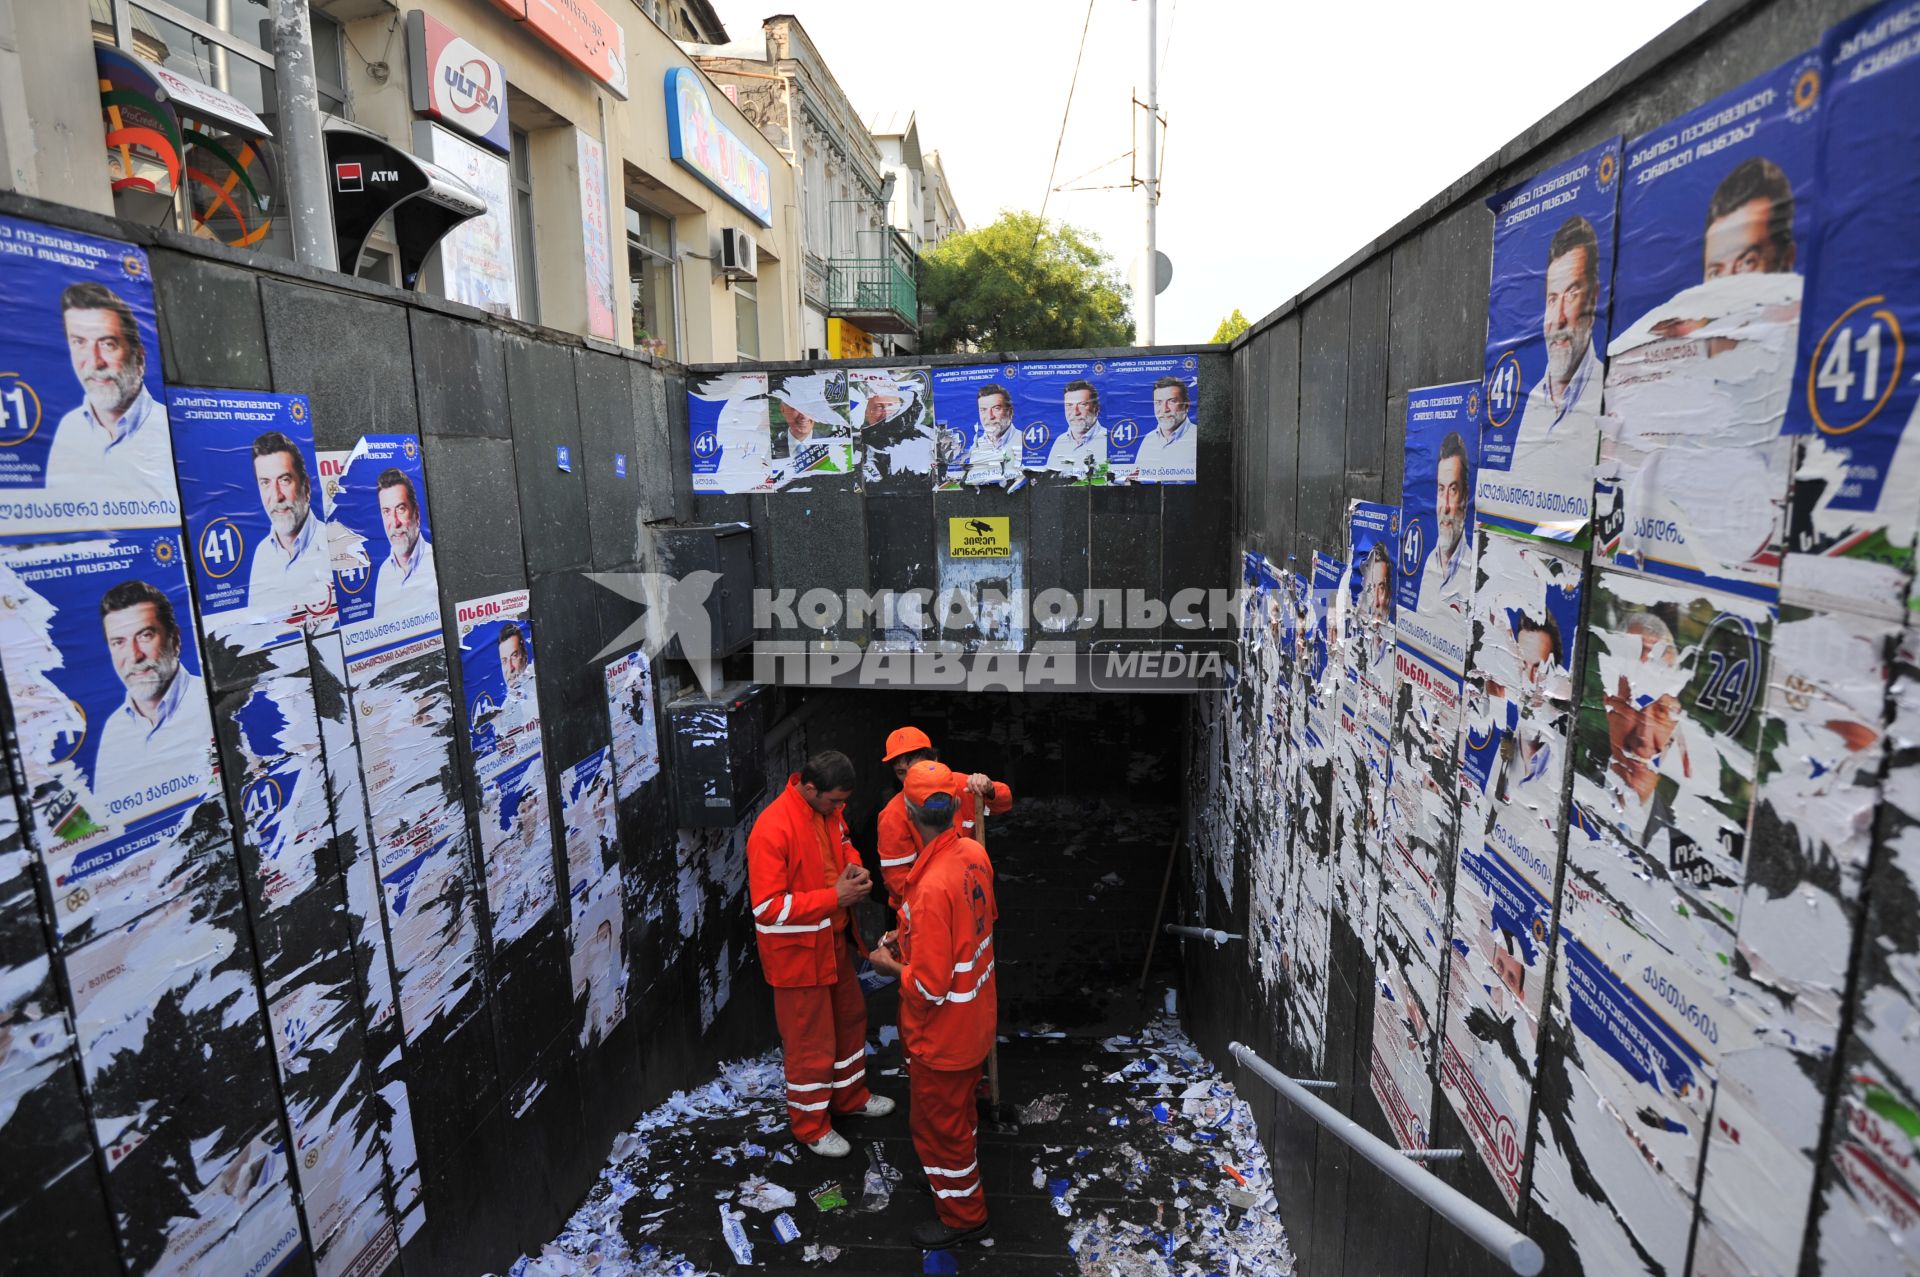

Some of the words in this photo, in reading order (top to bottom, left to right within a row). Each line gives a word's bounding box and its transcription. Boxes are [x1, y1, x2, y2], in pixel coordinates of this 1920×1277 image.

[444, 65, 499, 115] ULTRA
[371, 170, 399, 182] ATM
[1815, 328, 1880, 403] 41
[1490, 366, 1515, 409] 41
[696, 438, 714, 453] 41
[1025, 426, 1044, 443] 41
[1115, 425, 1133, 442] 41
[204, 528, 236, 564] 41
[951, 547, 1009, 557] კონტროლი
[963, 537, 996, 546] ვიდეო
[1403, 529, 1419, 565] 41
[1695, 651, 1748, 717] 24
